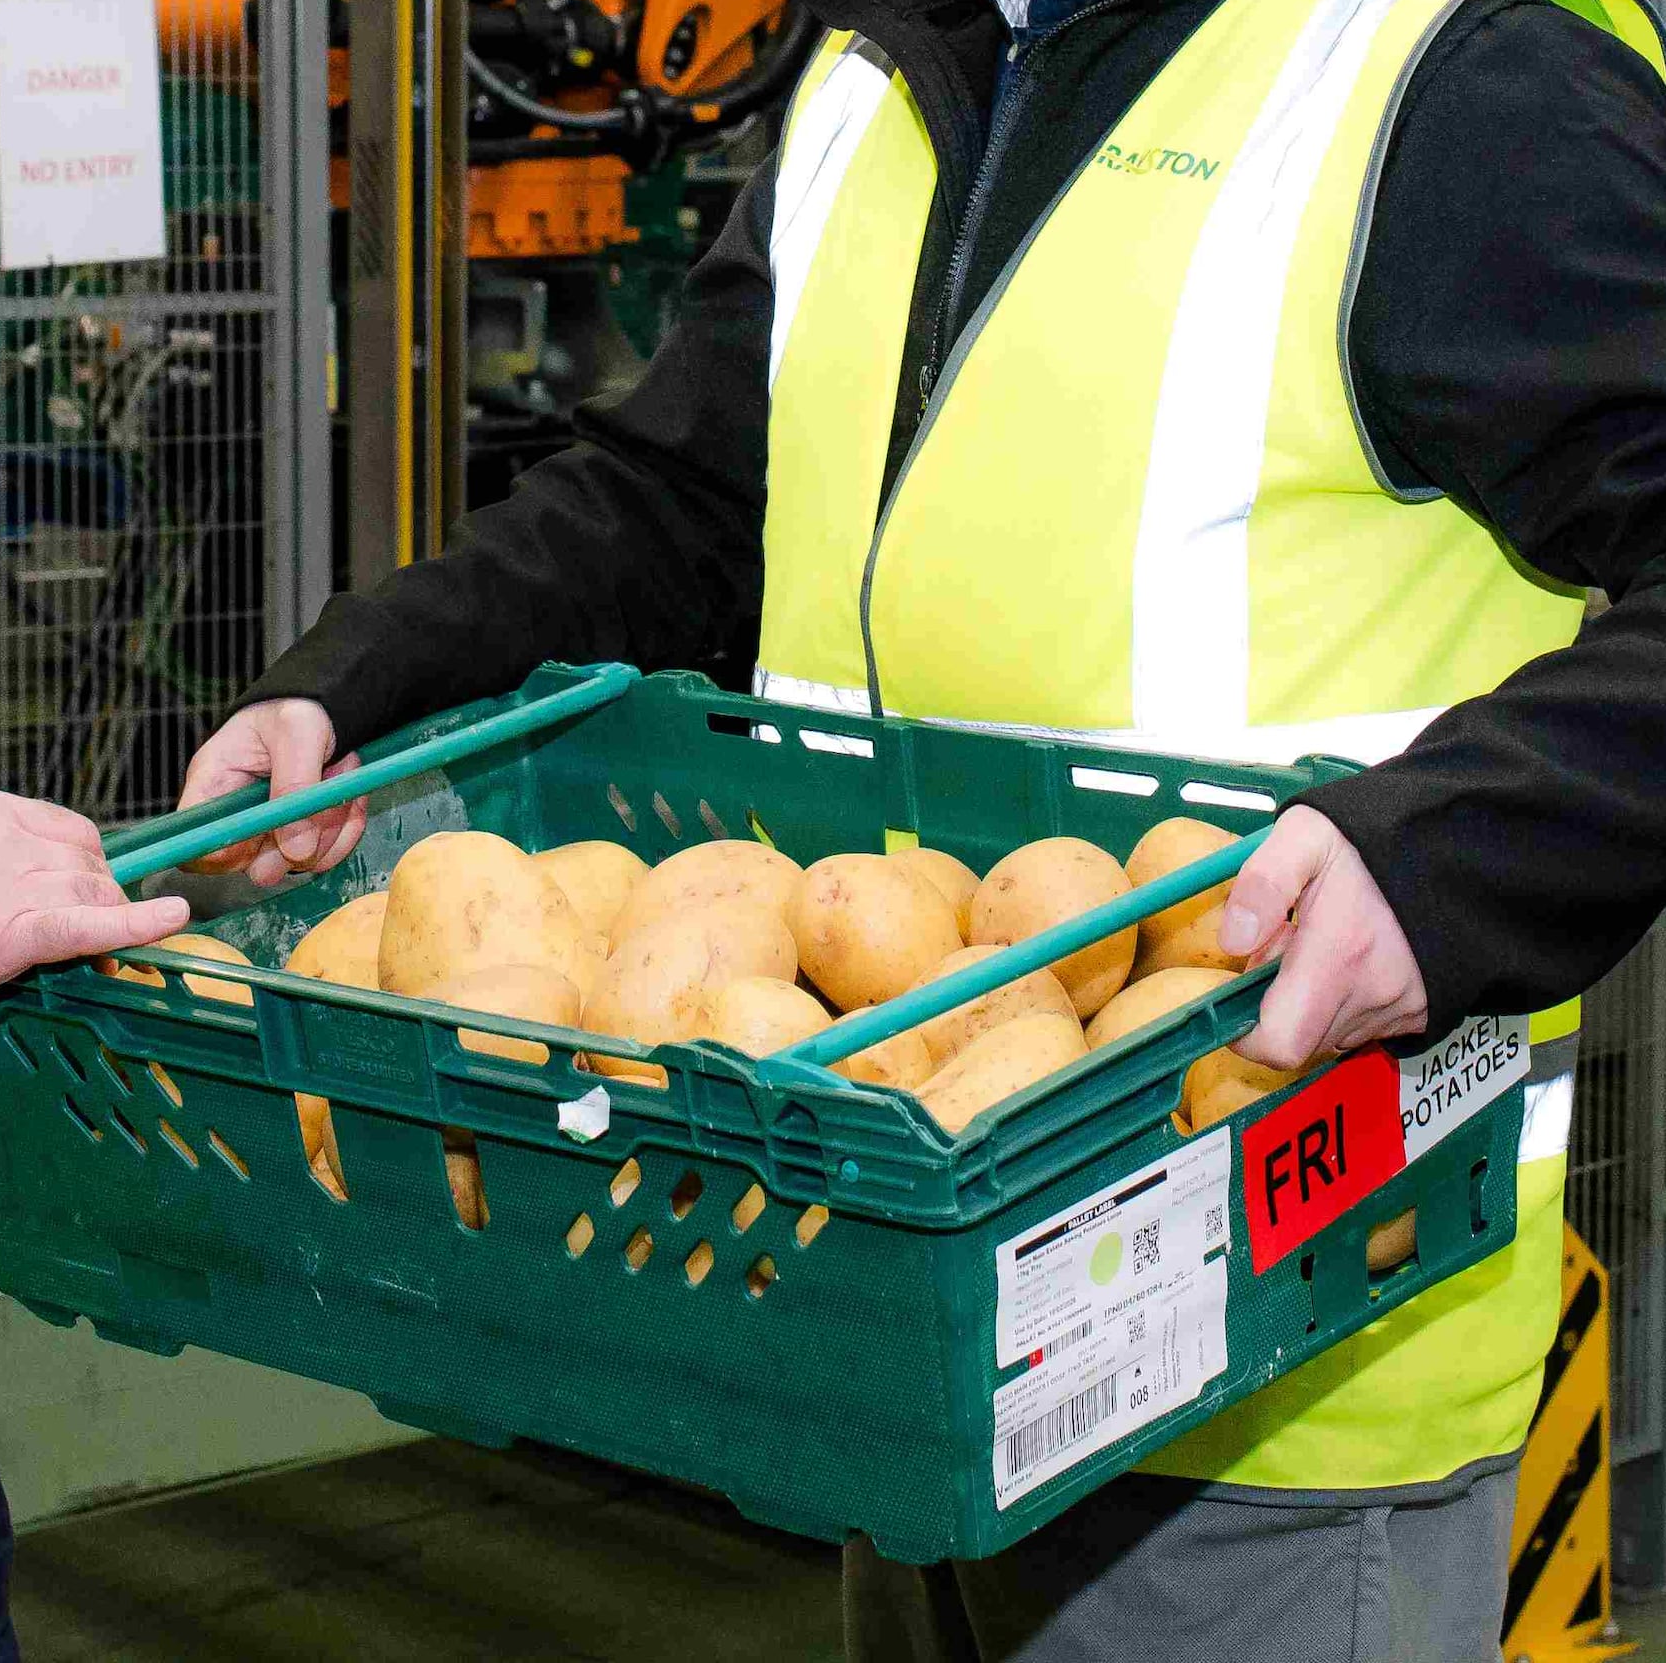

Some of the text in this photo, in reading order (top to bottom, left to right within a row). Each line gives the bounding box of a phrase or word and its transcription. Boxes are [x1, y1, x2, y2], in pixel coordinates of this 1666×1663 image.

[26, 68, 120, 93] DANGER
[19, 155, 136, 182] NO ENTRY
[1415, 1016, 1501, 1092] JACKET
[1401, 1032, 1520, 1140] POTATOES
[1264, 1103, 1346, 1227] FRI
[1067, 1196, 1116, 1230] PALLET LABEL
[1130, 1385, 1149, 1410] 008
